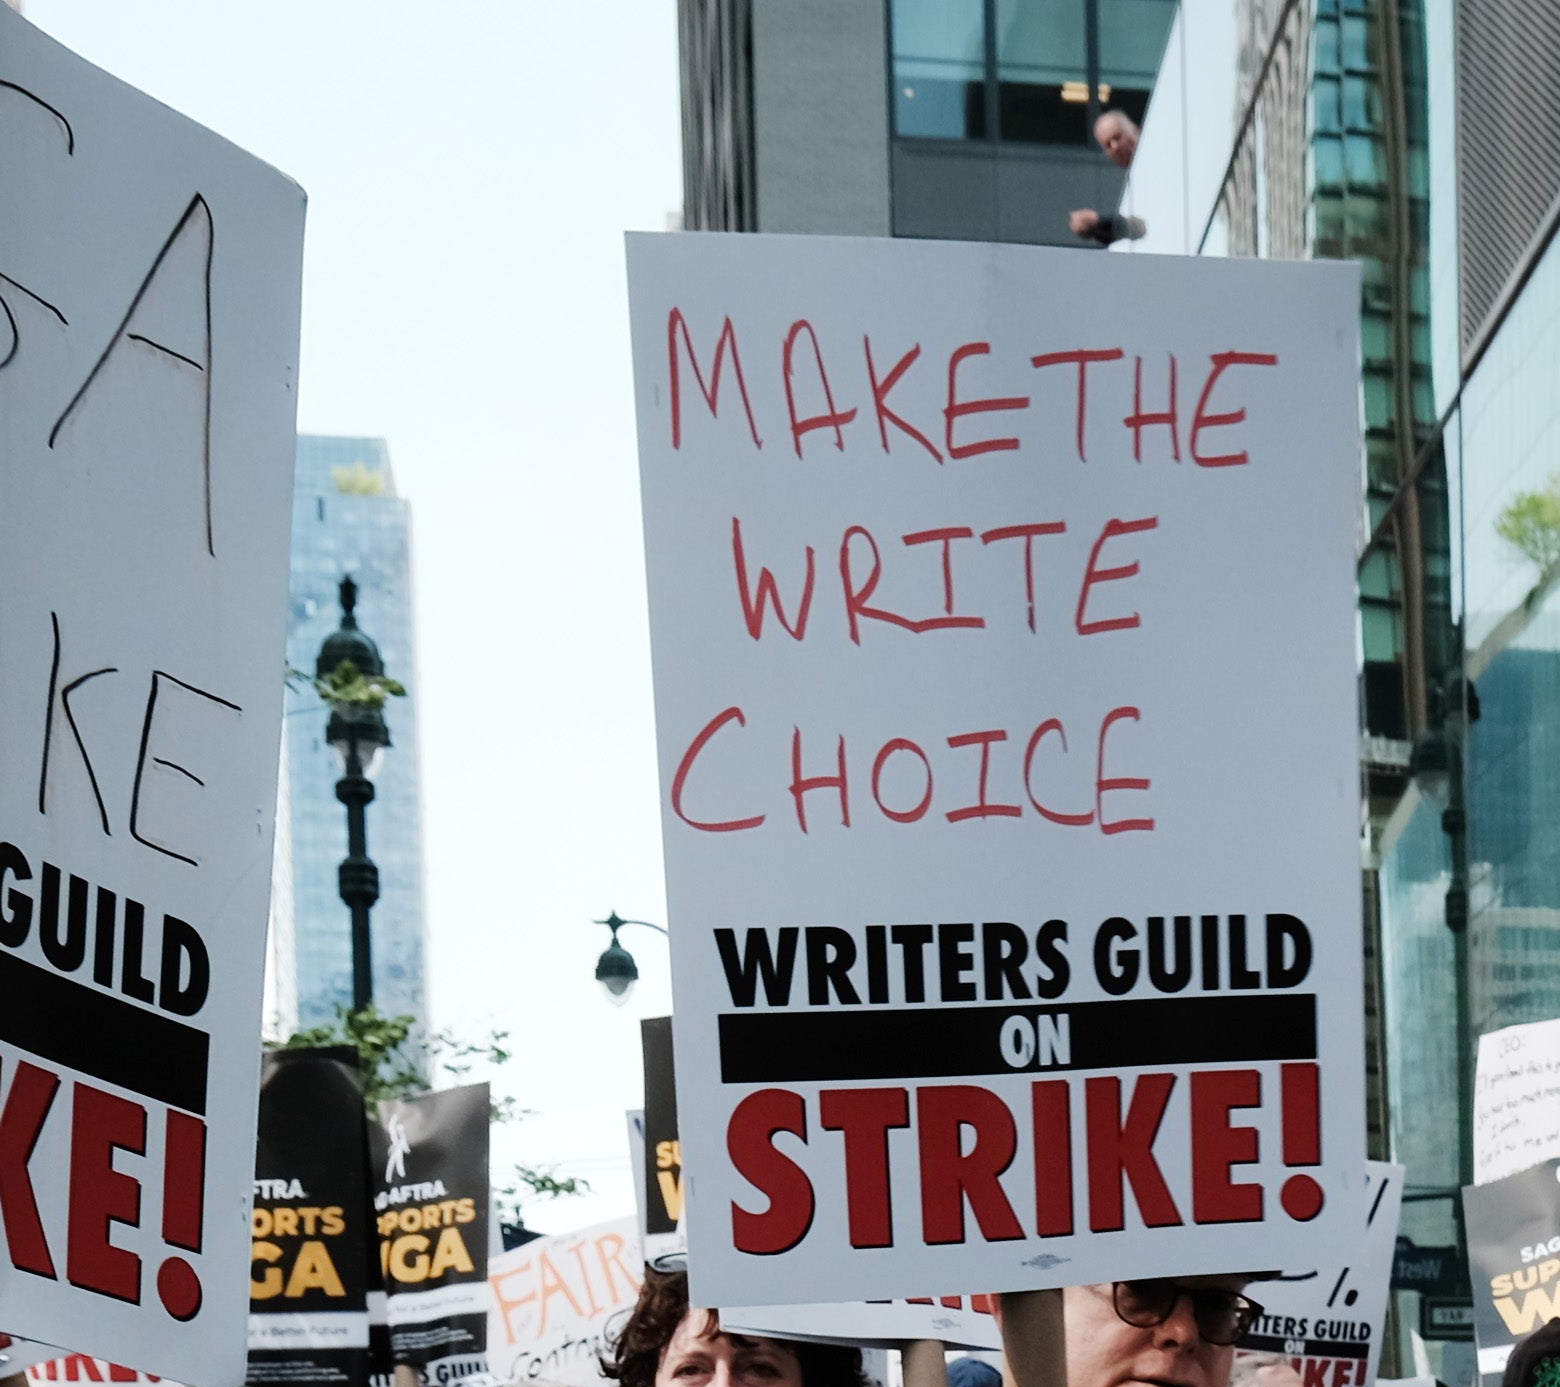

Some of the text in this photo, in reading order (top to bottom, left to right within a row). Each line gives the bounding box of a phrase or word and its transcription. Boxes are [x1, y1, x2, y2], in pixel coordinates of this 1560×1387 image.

[731, 515, 1159, 646] WRITE
[670, 706, 1156, 835] CHOICE
[713, 913, 1315, 1008] WRITERS GUILD
[998, 1013, 1073, 1068] ON
[726, 1061, 1329, 1257] STRIKE!
[251, 1205, 347, 1239] ORTS
[379, 1226, 476, 1284] GA
[249, 1240, 347, 1300] GA
[487, 1232, 643, 1346] FAIR
[1248, 1314, 1372, 1342] ITERS GUILD
